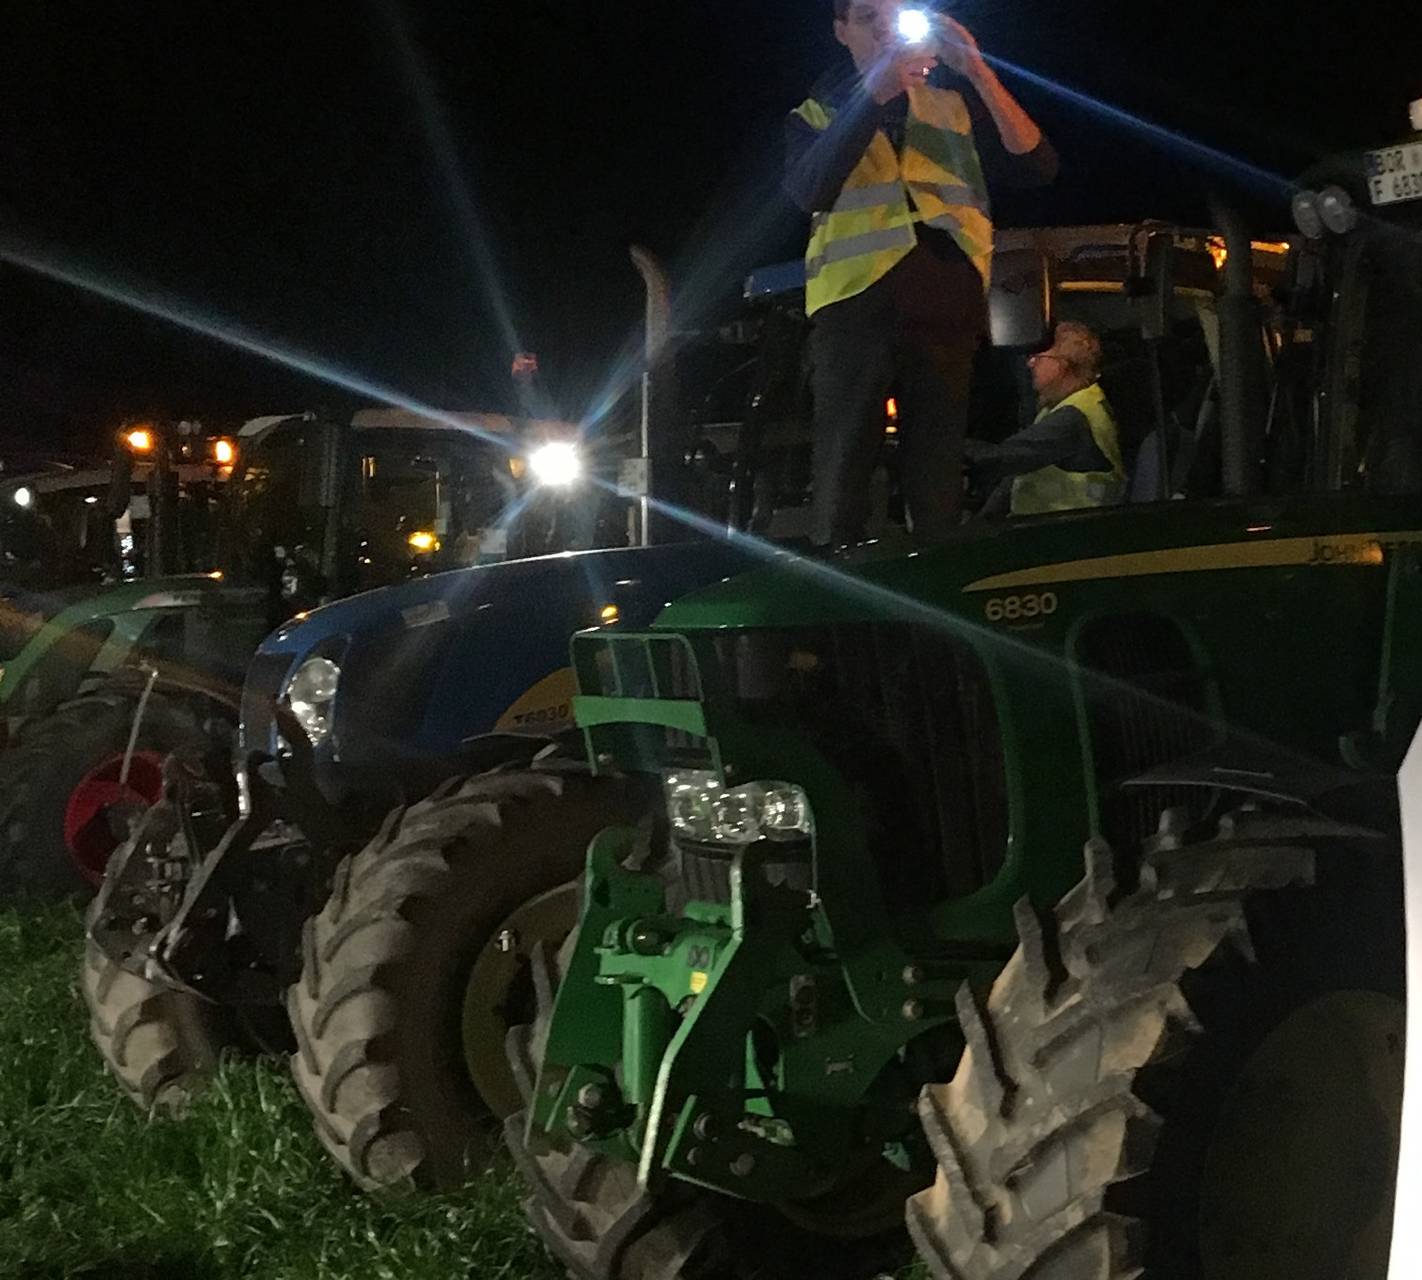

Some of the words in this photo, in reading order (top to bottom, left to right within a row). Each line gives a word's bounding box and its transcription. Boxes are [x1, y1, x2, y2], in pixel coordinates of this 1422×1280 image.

[1376, 150, 1405, 174] BOR
[1374, 180, 1383, 201] F
[985, 592, 1058, 620] 6830
